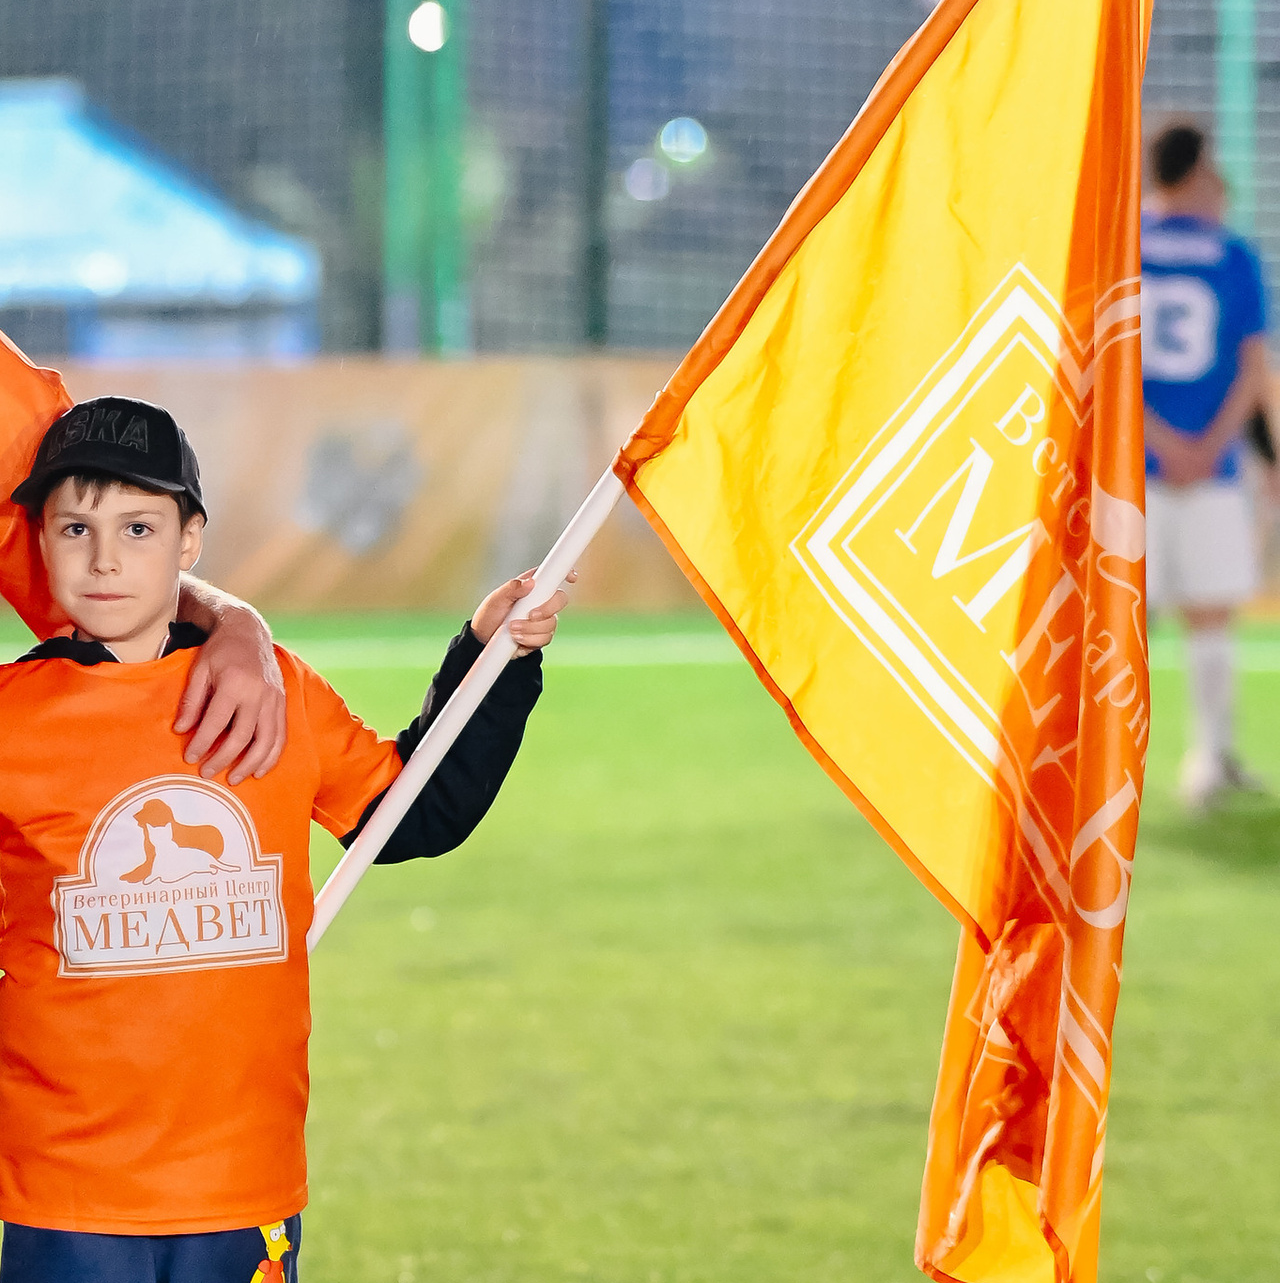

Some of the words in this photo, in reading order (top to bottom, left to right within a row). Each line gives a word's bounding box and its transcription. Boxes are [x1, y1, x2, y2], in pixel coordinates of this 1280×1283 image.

[73, 881, 219, 910] Ветеринарный
[225, 878, 271, 899] Центр
[72, 898, 273, 956] МЕДВЕТ
